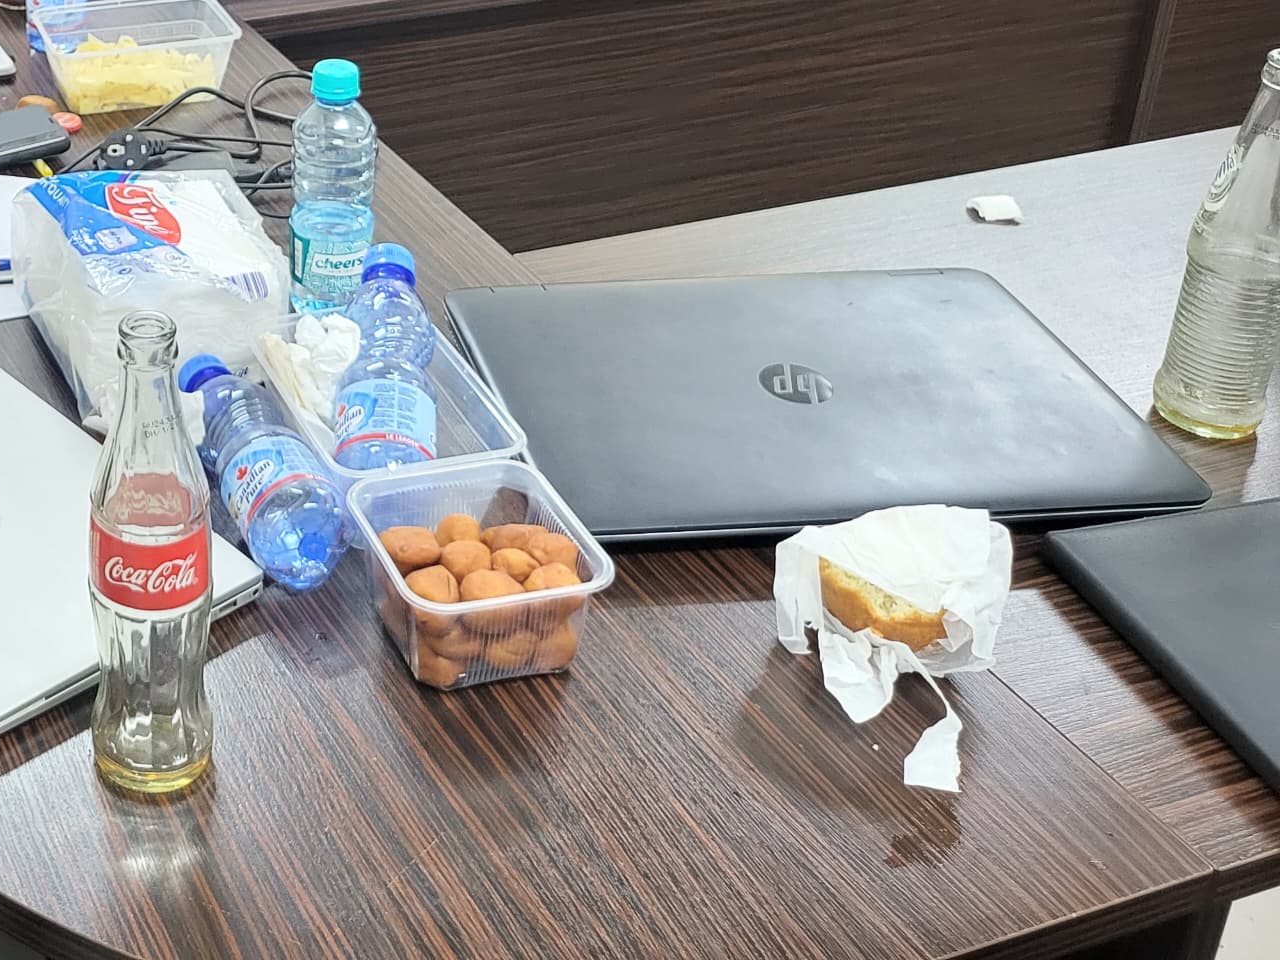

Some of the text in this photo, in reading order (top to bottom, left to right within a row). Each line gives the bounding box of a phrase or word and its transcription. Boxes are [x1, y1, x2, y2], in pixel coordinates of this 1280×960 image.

[111, 186, 177, 236] Fine
[314, 254, 363, 271] cheers
[235, 459, 272, 512] Canadian
[245, 477, 265, 505] Pure
[103, 551, 198, 594] Coca-Cola
